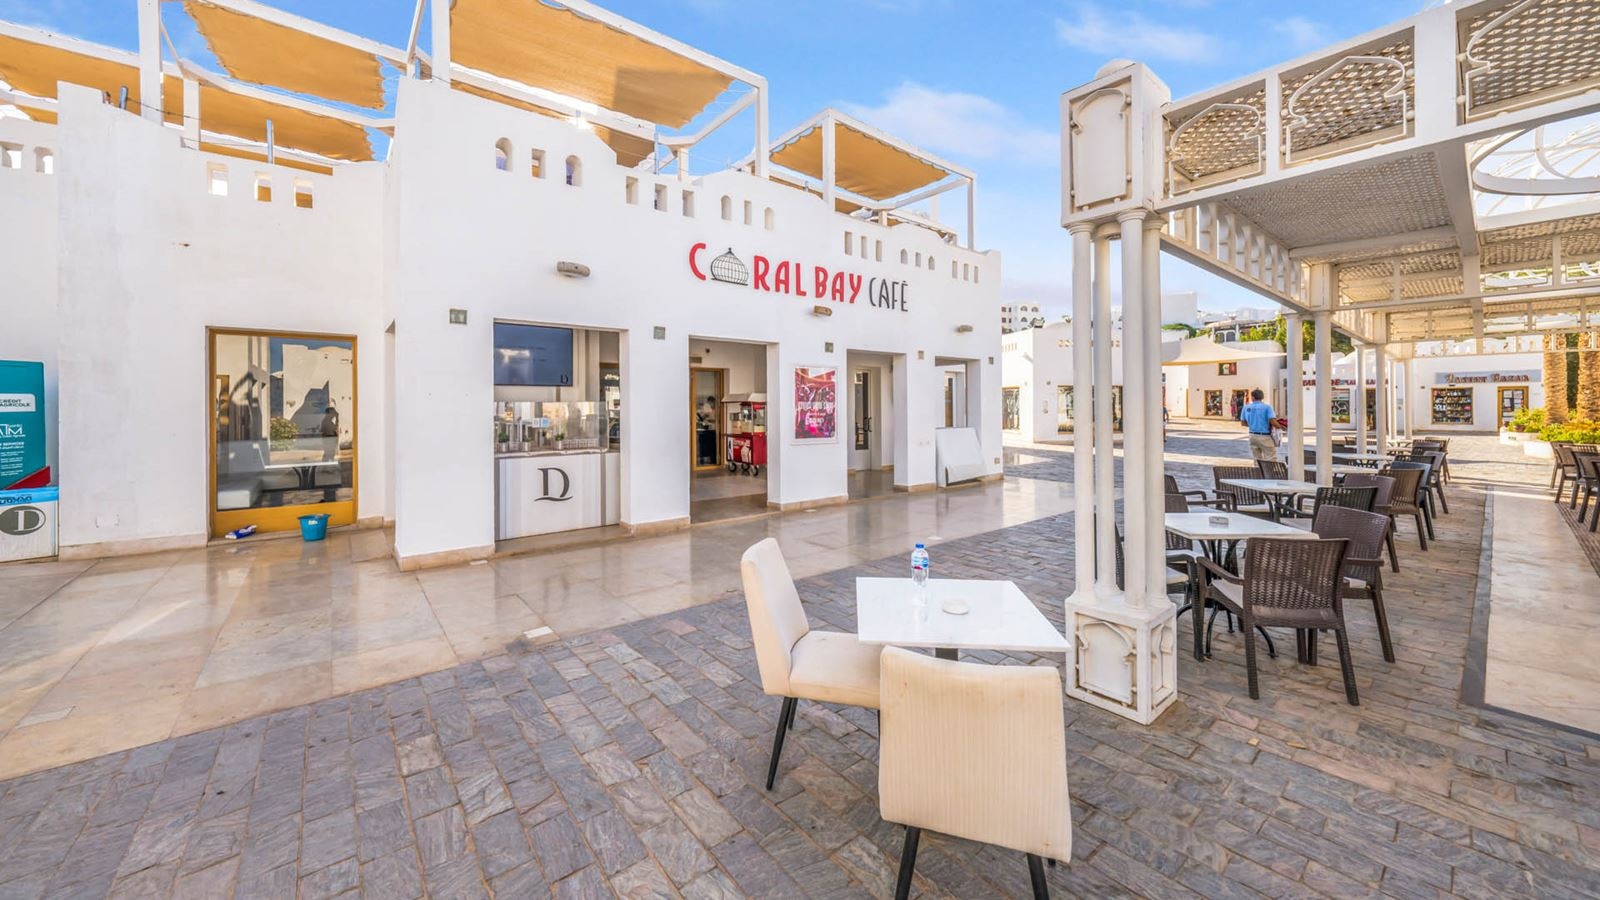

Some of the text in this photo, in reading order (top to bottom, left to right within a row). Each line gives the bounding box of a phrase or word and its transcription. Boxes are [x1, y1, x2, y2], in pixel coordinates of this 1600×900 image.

[815, 265, 862, 304] BAY
[535, 466, 573, 501] D
[14, 509, 45, 532] D
